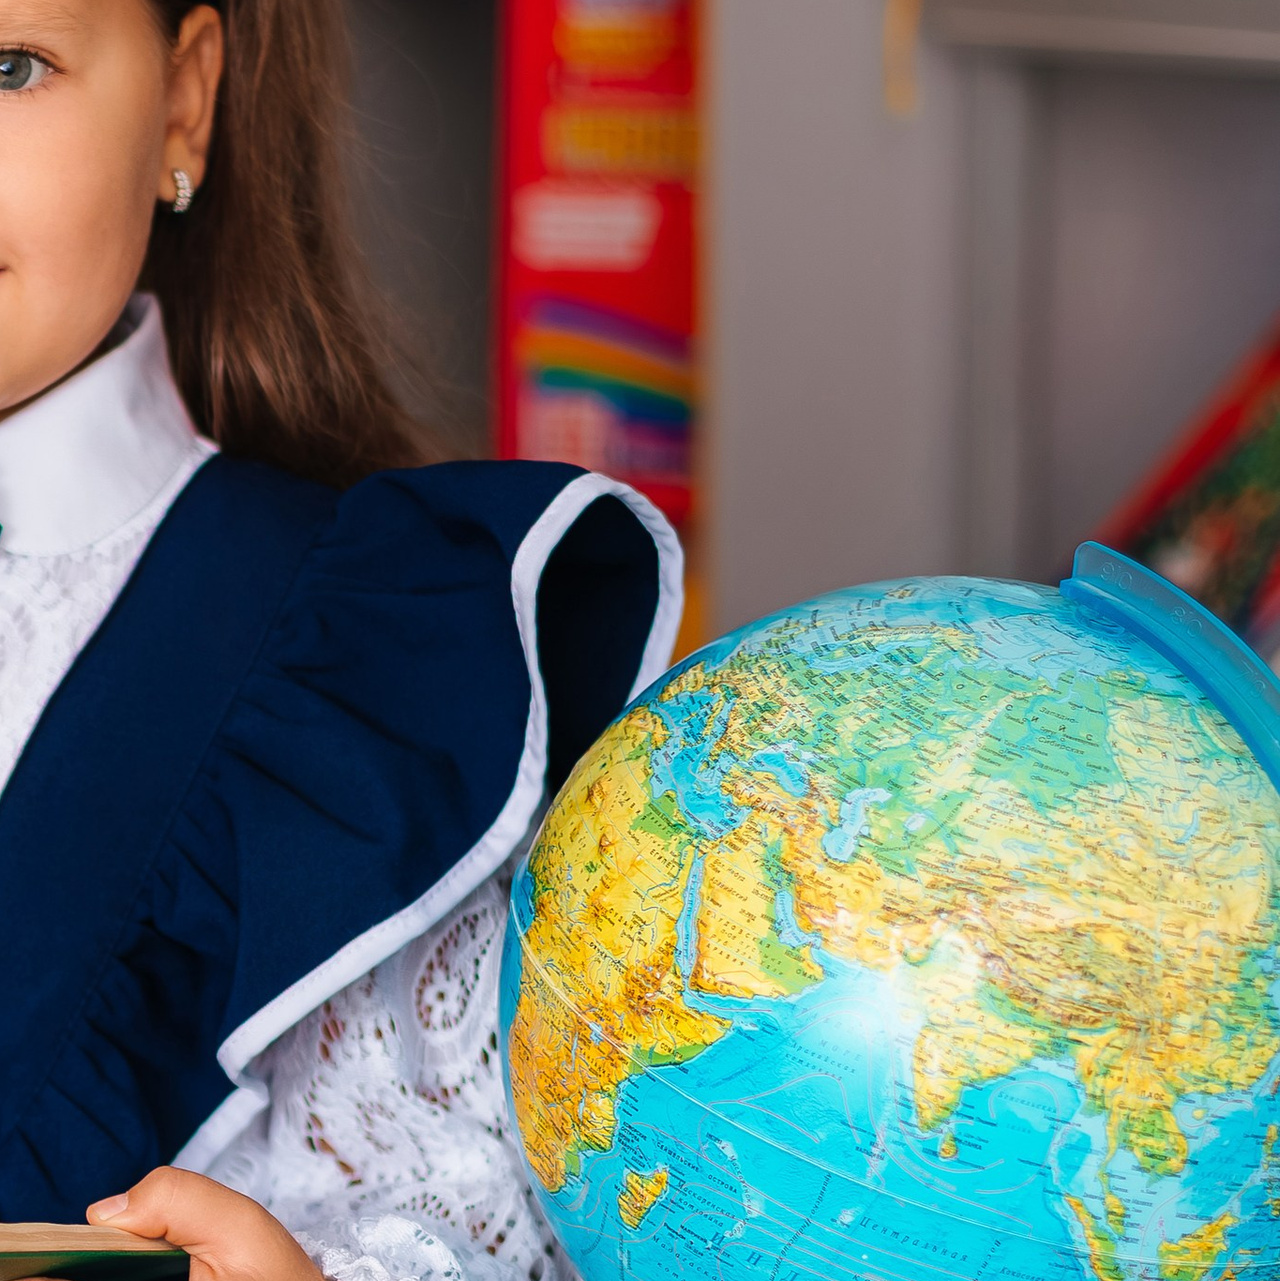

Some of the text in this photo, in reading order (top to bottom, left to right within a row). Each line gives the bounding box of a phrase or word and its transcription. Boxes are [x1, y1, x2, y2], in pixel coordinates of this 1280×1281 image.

[650, 848, 675, 871] ЕГИПЕТ
[796, 968, 819, 982] ОМАН
[656, 1142, 699, 1172] СЕЙШЕЛЬСКИЕ
[708, 1173, 738, 1194] ОСТРОВА
[678, 1181, 736, 1219] Маскаренская
[678, 1197, 724, 1228] котловина
[860, 1216, 969, 1263] Центральная
